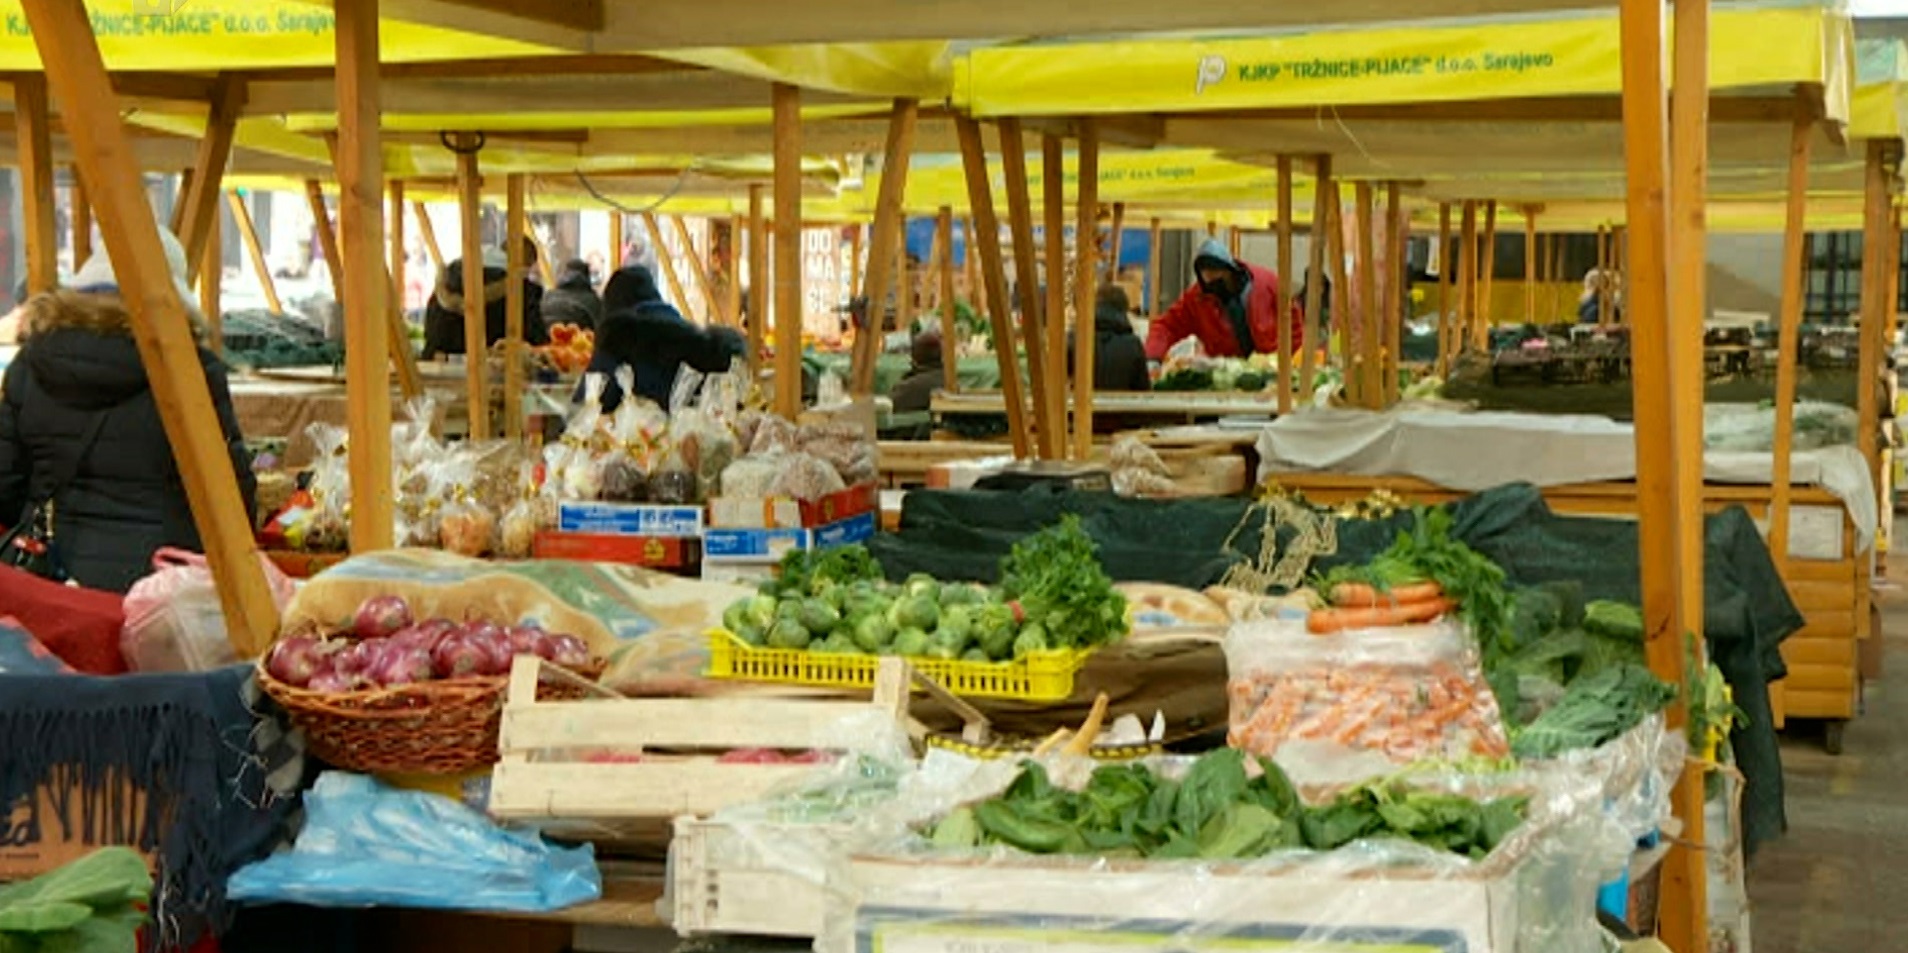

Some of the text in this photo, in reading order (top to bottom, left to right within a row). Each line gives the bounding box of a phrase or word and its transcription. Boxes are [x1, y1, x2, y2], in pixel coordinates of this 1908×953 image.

[1239, 65, 1281, 82] KJKP
[1436, 54, 1477, 73] d.o.o.
[1484, 50, 1554, 73] Sarajevo
